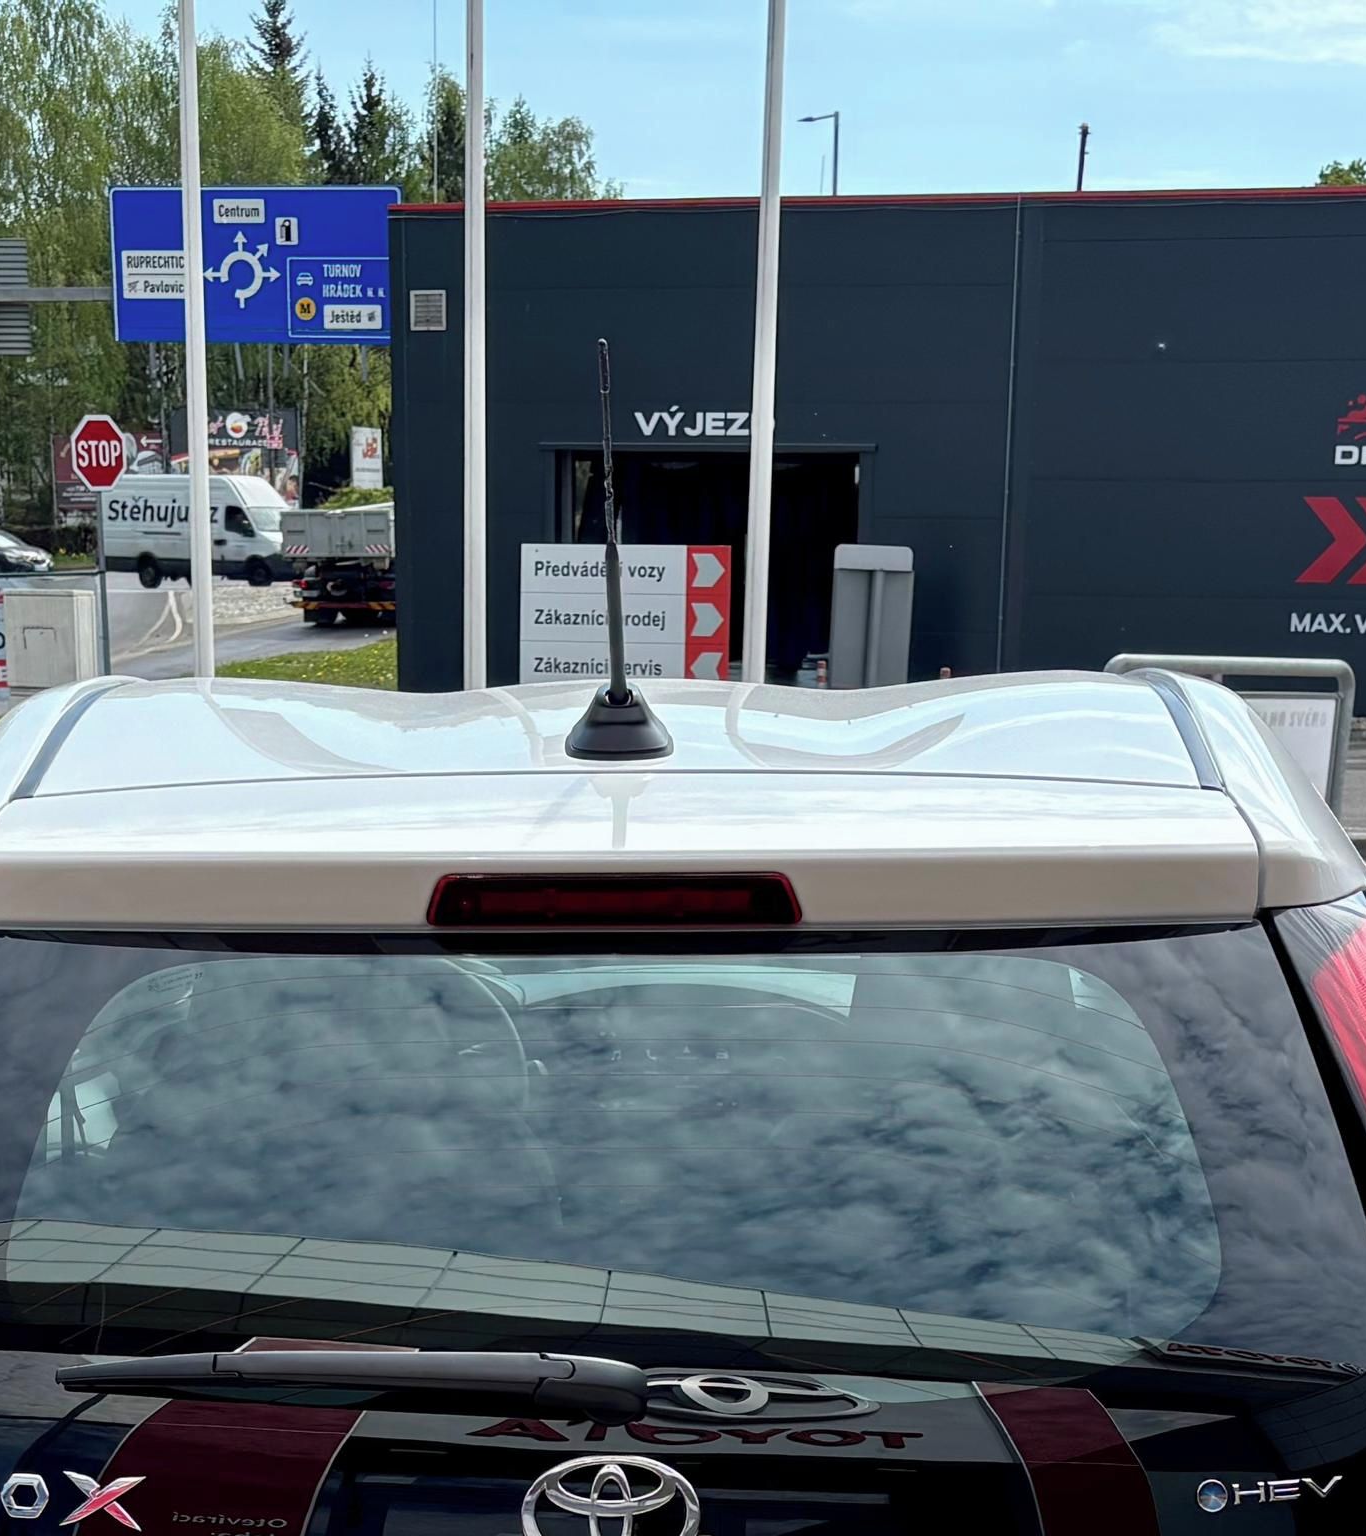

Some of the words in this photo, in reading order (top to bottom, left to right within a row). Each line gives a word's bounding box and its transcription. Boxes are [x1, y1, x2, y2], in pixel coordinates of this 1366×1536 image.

[218, 204, 260, 218] Centrum
[126, 255, 185, 269] RUPRECHTIC
[322, 264, 362, 278] TURNOV
[143, 280, 185, 293] Pavlovic
[322, 281, 363, 298] HRÁDEK
[330, 310, 362, 323] Ještěd
[635, 405, 775, 436] VÝJEZ
[77, 439, 121, 468] STOP
[108, 496, 218, 528] Stěhujuz
[534, 560, 623, 577] Předváděí
[628, 566, 666, 582] vozy
[623, 611, 666, 631] rodej
[1290, 612, 1351, 634] MAX.
[533, 657, 609, 674] Zákazníci
[623, 660, 663, 676] ervis
[1232, 1475, 1343, 1505] HEV
[59, 1470, 146, 1532] X
